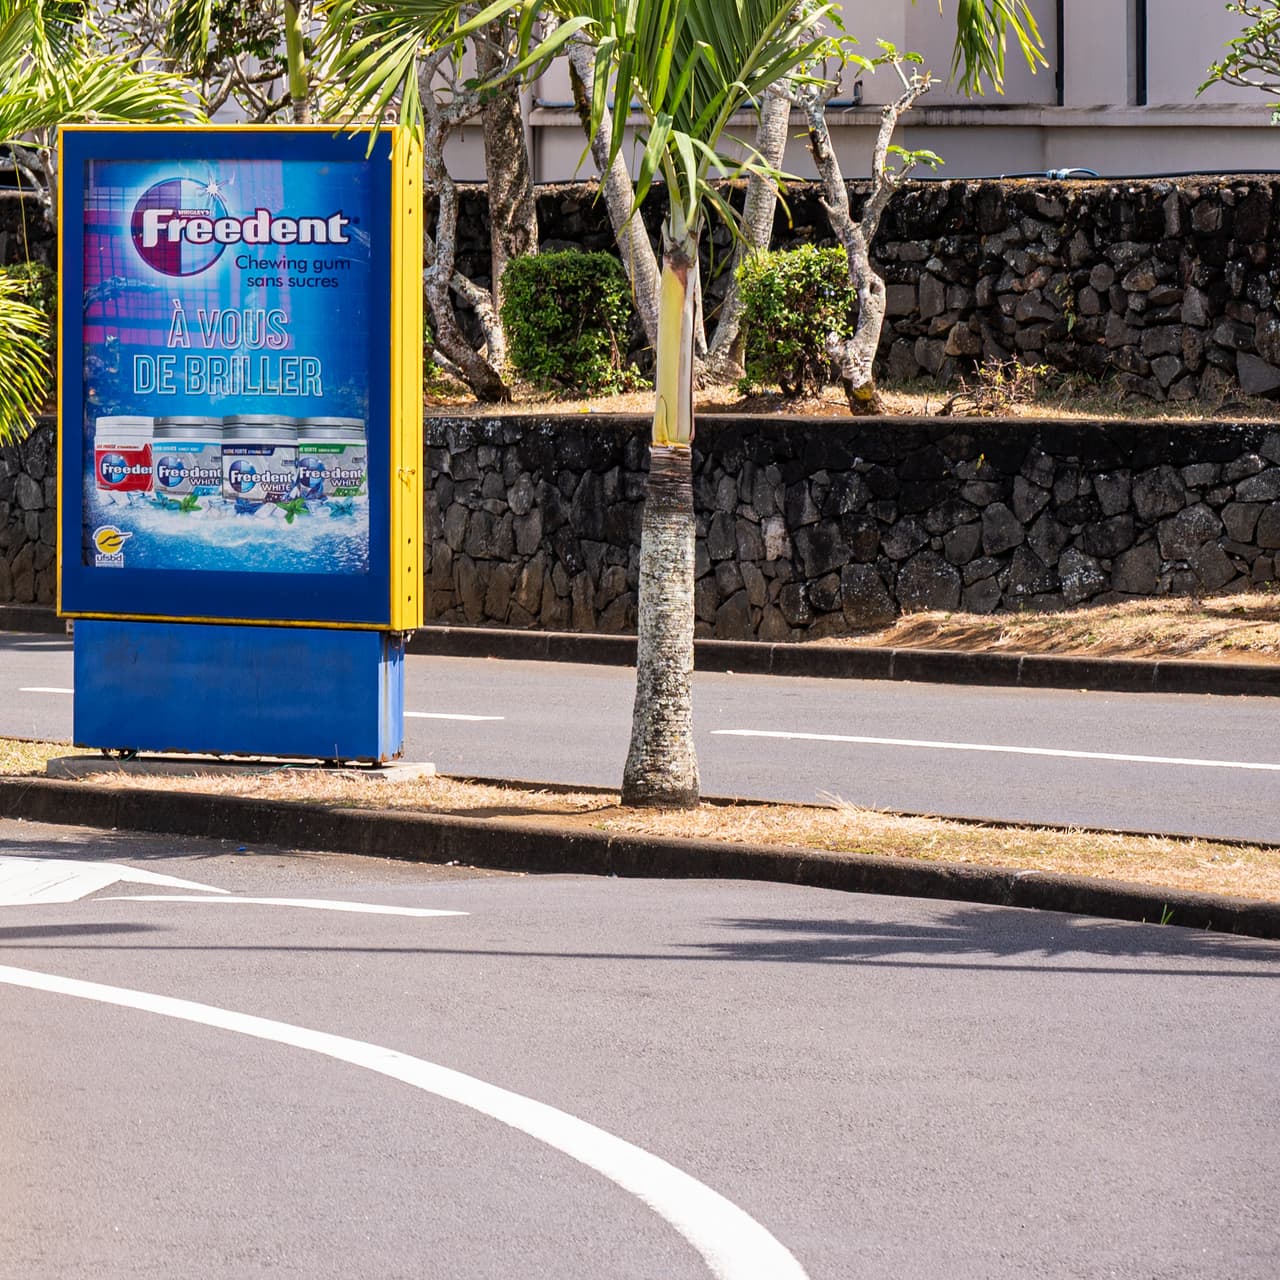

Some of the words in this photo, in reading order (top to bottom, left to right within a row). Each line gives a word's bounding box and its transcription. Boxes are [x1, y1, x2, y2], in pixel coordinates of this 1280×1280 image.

[142, 207, 350, 248] Freedent
[235, 255, 307, 272] Chewing
[312, 259, 351, 272] gum
[247, 276, 283, 287] sans
[288, 276, 339, 288] sucres
[167, 298, 191, 349] À
[197, 308, 290, 351] VOUS
[133, 354, 177, 395] DE
[184, 355, 323, 397] BRILLER
[230, 469, 295, 484] Freedent
[300, 465, 362, 479] Freedent
[260, 482, 291, 492] WHITE
[330, 479, 361, 487] WHITE
